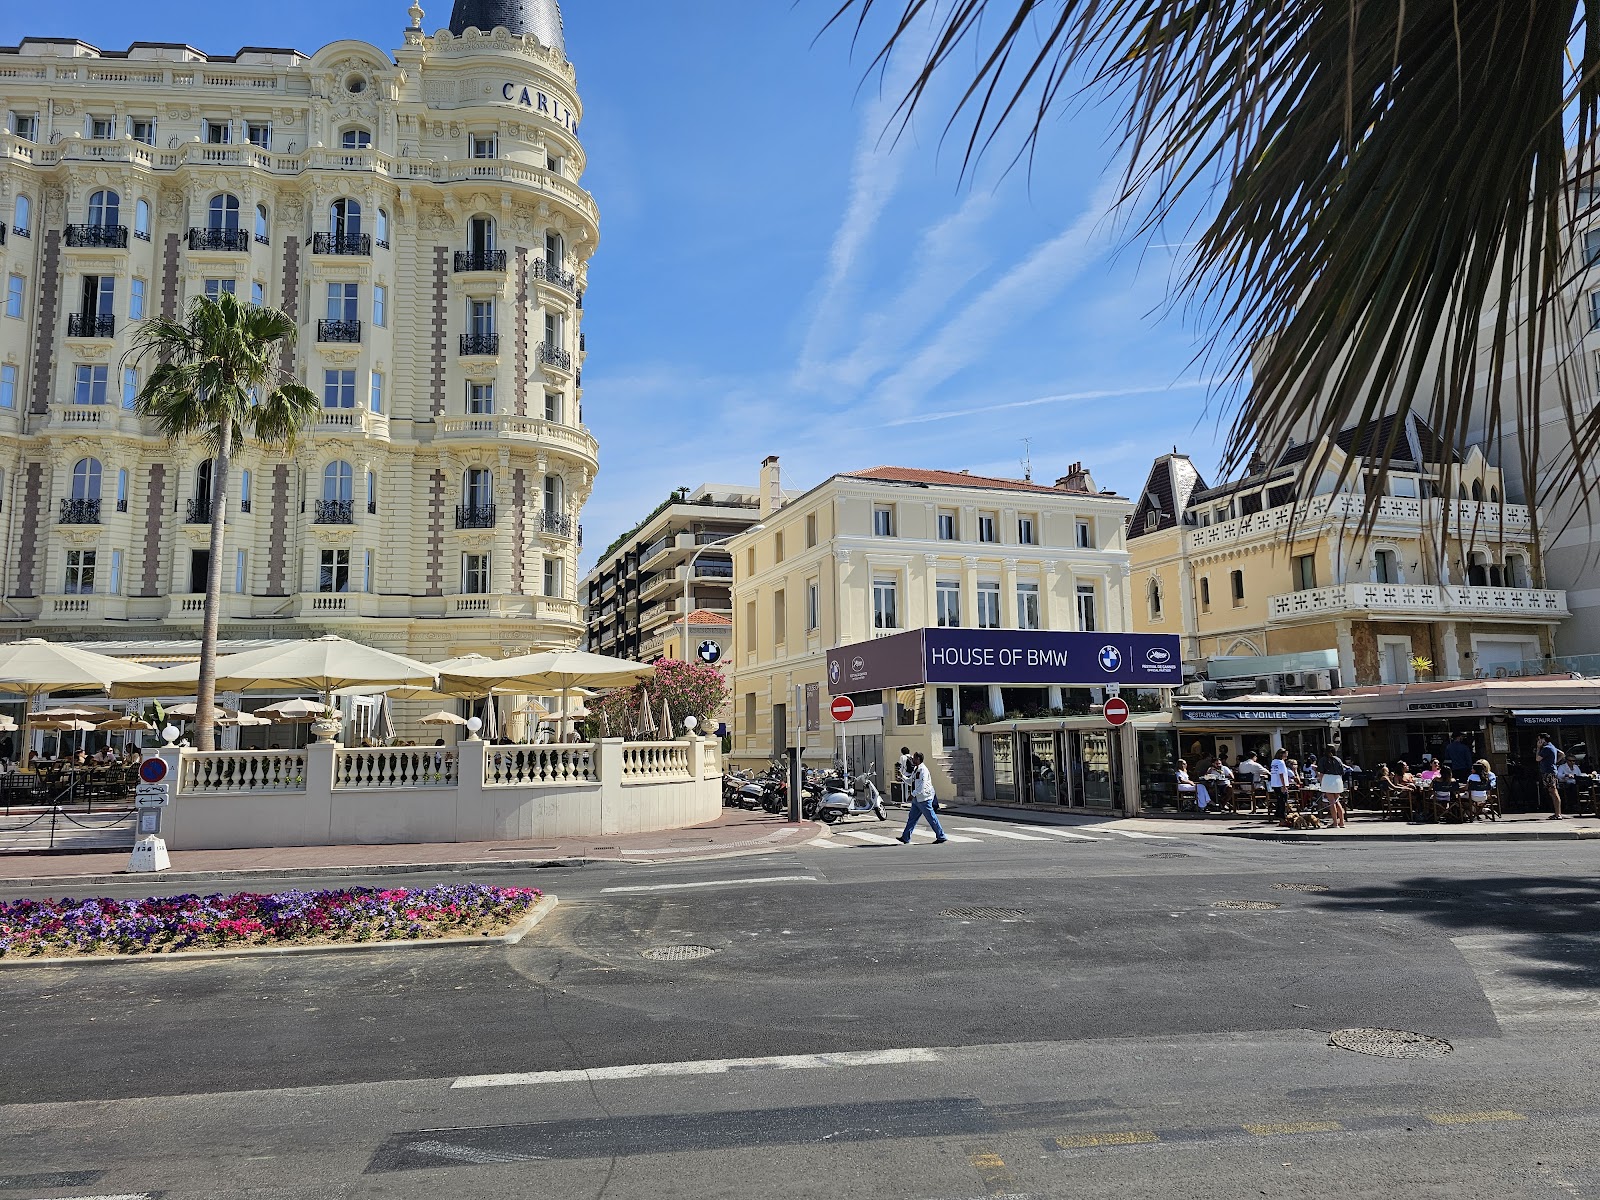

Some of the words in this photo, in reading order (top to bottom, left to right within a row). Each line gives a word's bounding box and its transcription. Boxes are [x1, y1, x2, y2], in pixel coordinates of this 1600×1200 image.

[932, 647, 995, 666] HOUSE
[999, 648, 1023, 666] OF
[1027, 649, 1068, 667] BMW
[1239, 711, 1251, 719] LE
[1252, 711, 1288, 719] VOILIER
